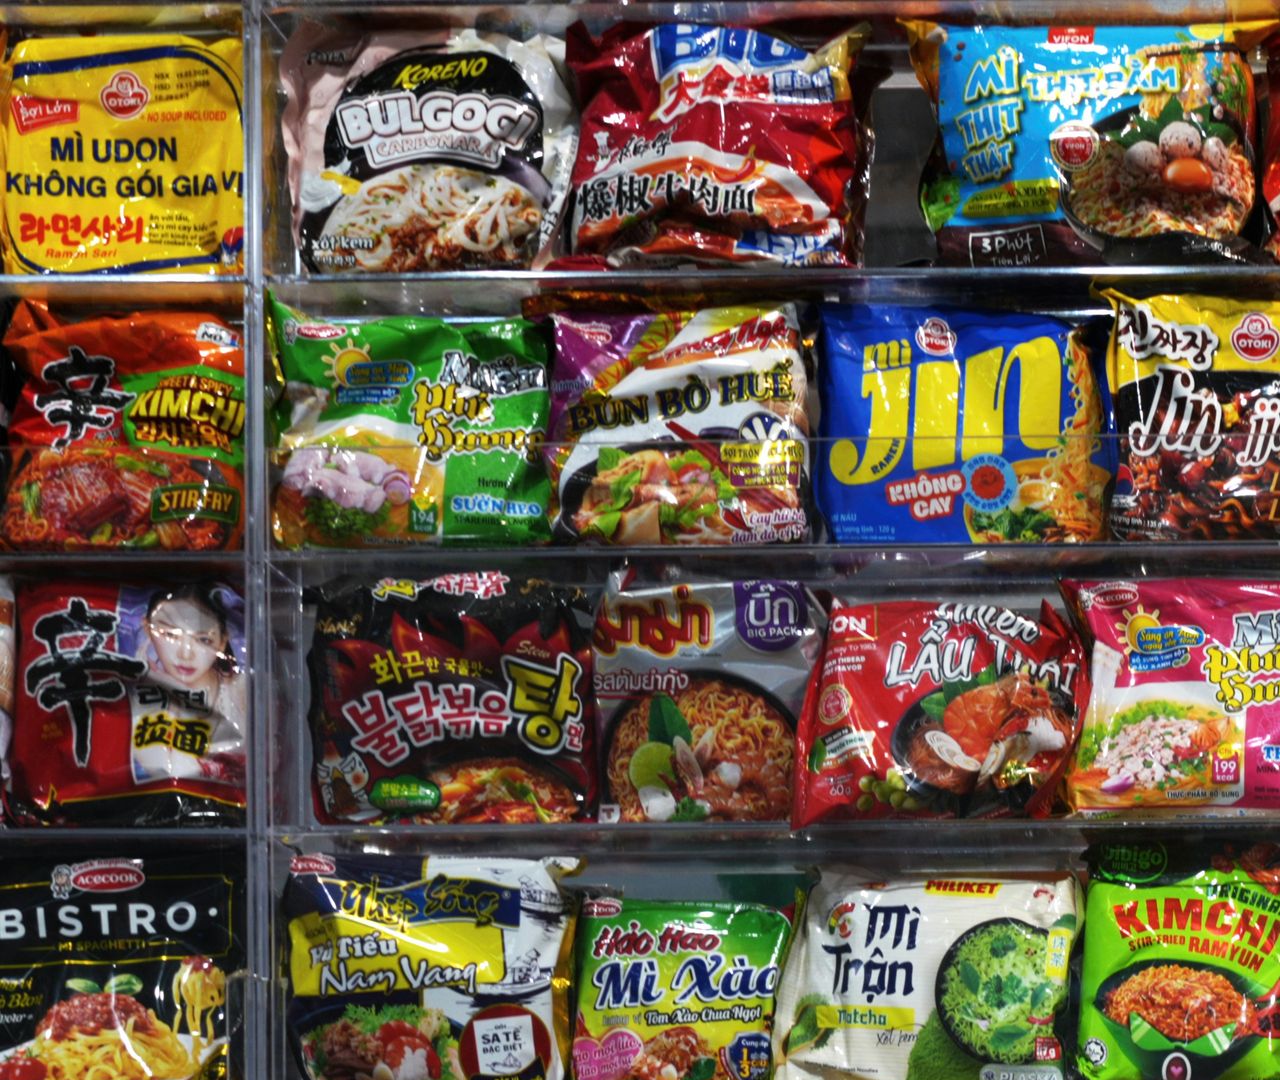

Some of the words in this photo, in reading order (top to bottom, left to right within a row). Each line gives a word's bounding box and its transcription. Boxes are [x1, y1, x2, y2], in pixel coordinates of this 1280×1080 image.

[1053, 34, 1090, 44] VIFON
[396, 57, 488, 88] KORENO
[50, 137, 83, 162] MÌ
[92, 138, 177, 163] UDON
[6, 171, 106, 197] KHÔNG
[116, 171, 164, 197] GÓI
[173, 174, 217, 196] GIA
[982, 238, 990, 252] 3
[1238, 338, 1274, 349] OTOKI
[567, 396, 649, 431] BÚN
[661, 379, 710, 418] BÒ
[719, 358, 794, 407] HUẾ
[129, 389, 245, 428] KIMCHI
[914, 496, 953, 517] CAY
[1213, 760, 1236, 772] 199
[926, 880, 1000, 895] MILIKET
[74, 941, 143, 950] SPAGHETTI
[1189, 936, 1264, 971] RAMYUN
[323, 962, 395, 996] Nam
[403, 957, 476, 992] Vang
[597, 962, 661, 1007] Mì
[823, 943, 914, 1002] Trộn
[702, 1009, 731, 1022] Chua
